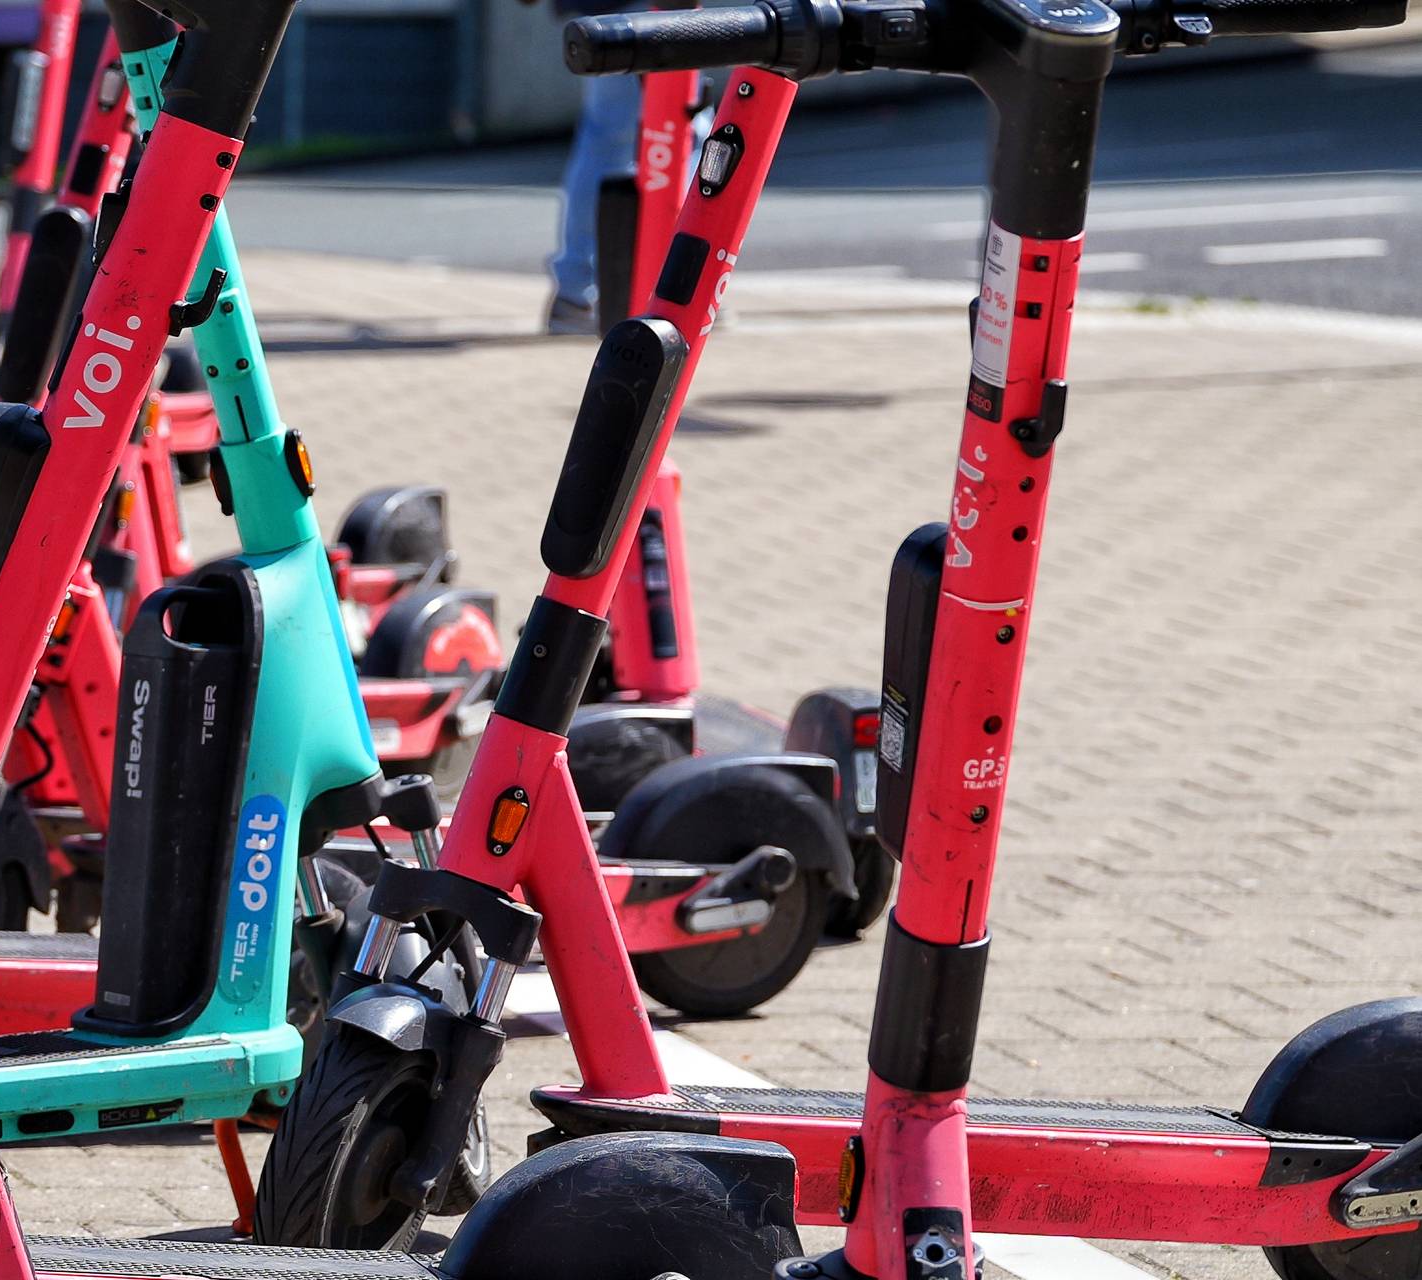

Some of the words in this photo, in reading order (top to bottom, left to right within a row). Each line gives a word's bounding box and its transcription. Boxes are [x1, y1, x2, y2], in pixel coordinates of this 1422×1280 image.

[1046, 6, 1094, 17] voi.
[643, 120, 675, 191] voi.
[63, 315, 142, 429] voi.
[201, 685, 217, 745] TIER
[239, 813, 279, 912] dott
[230, 921, 250, 982] TIER
[249, 923, 260, 946] now
